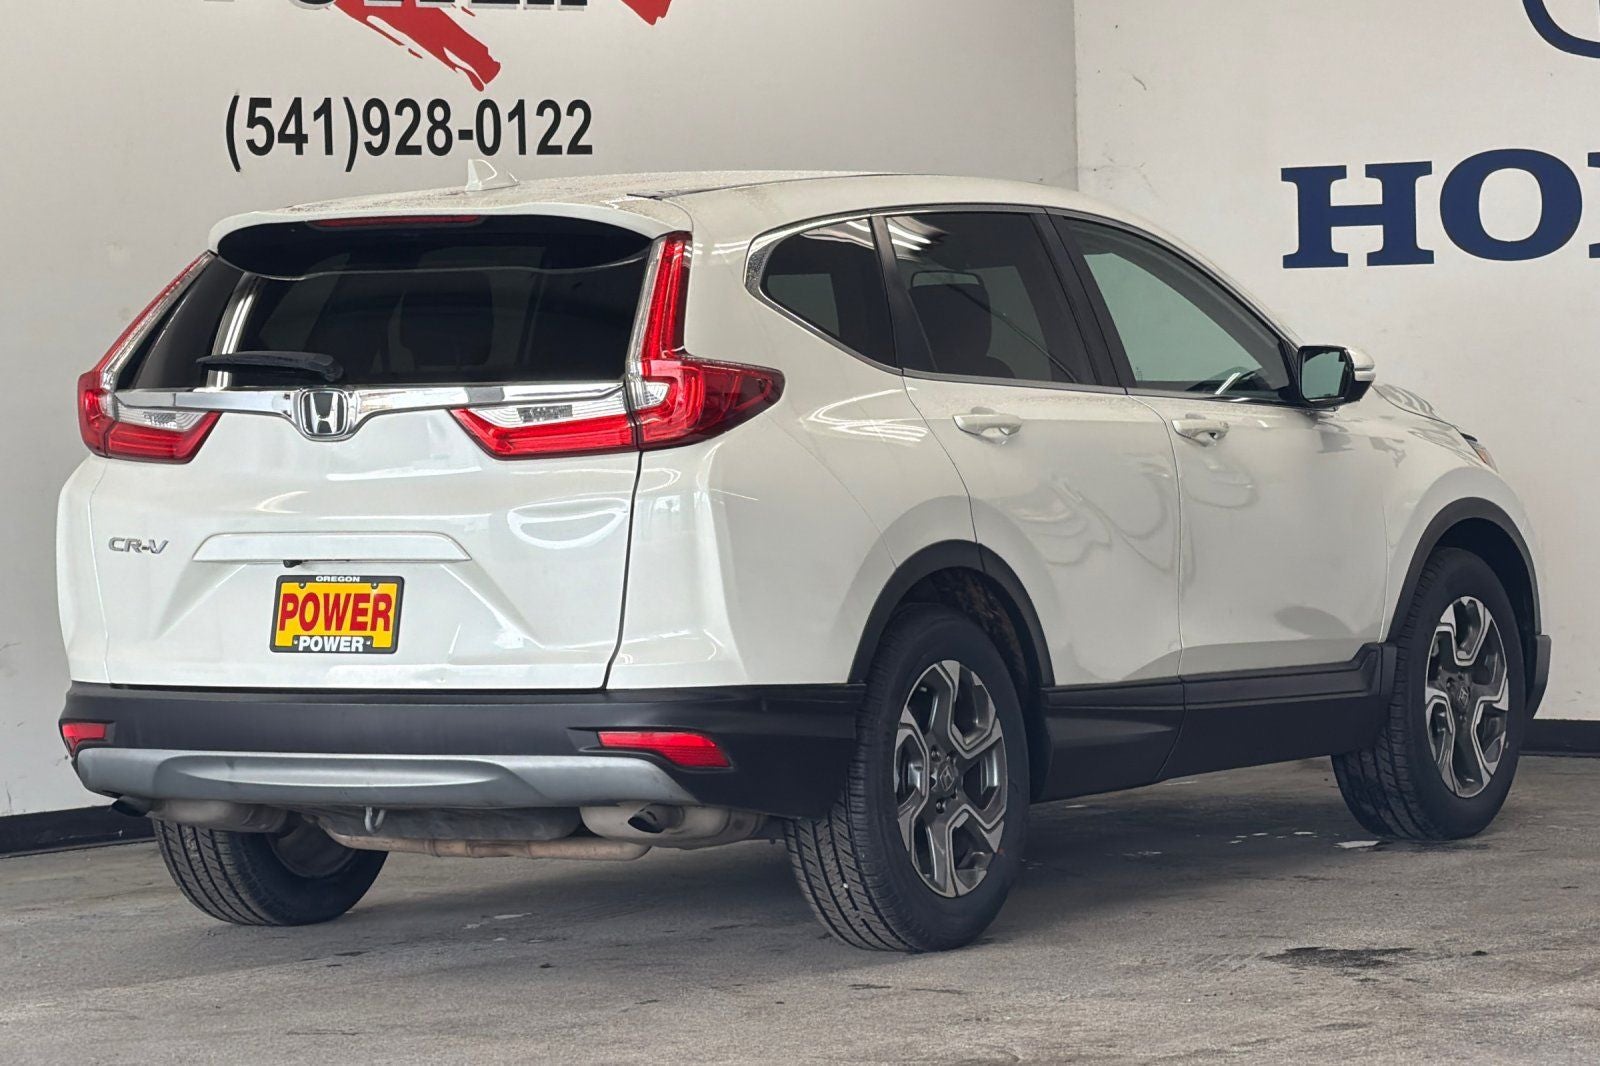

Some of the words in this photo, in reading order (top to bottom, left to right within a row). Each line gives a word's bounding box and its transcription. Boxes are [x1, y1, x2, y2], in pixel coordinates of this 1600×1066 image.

[225, 94, 594, 173] (541)928-0122
[1280, 148, 1600, 269] HO
[108, 536, 169, 554] CR-V
[315, 575, 361, 583] OREGON
[278, 592, 393, 632] POWER
[298, 636, 365, 652] POWER
